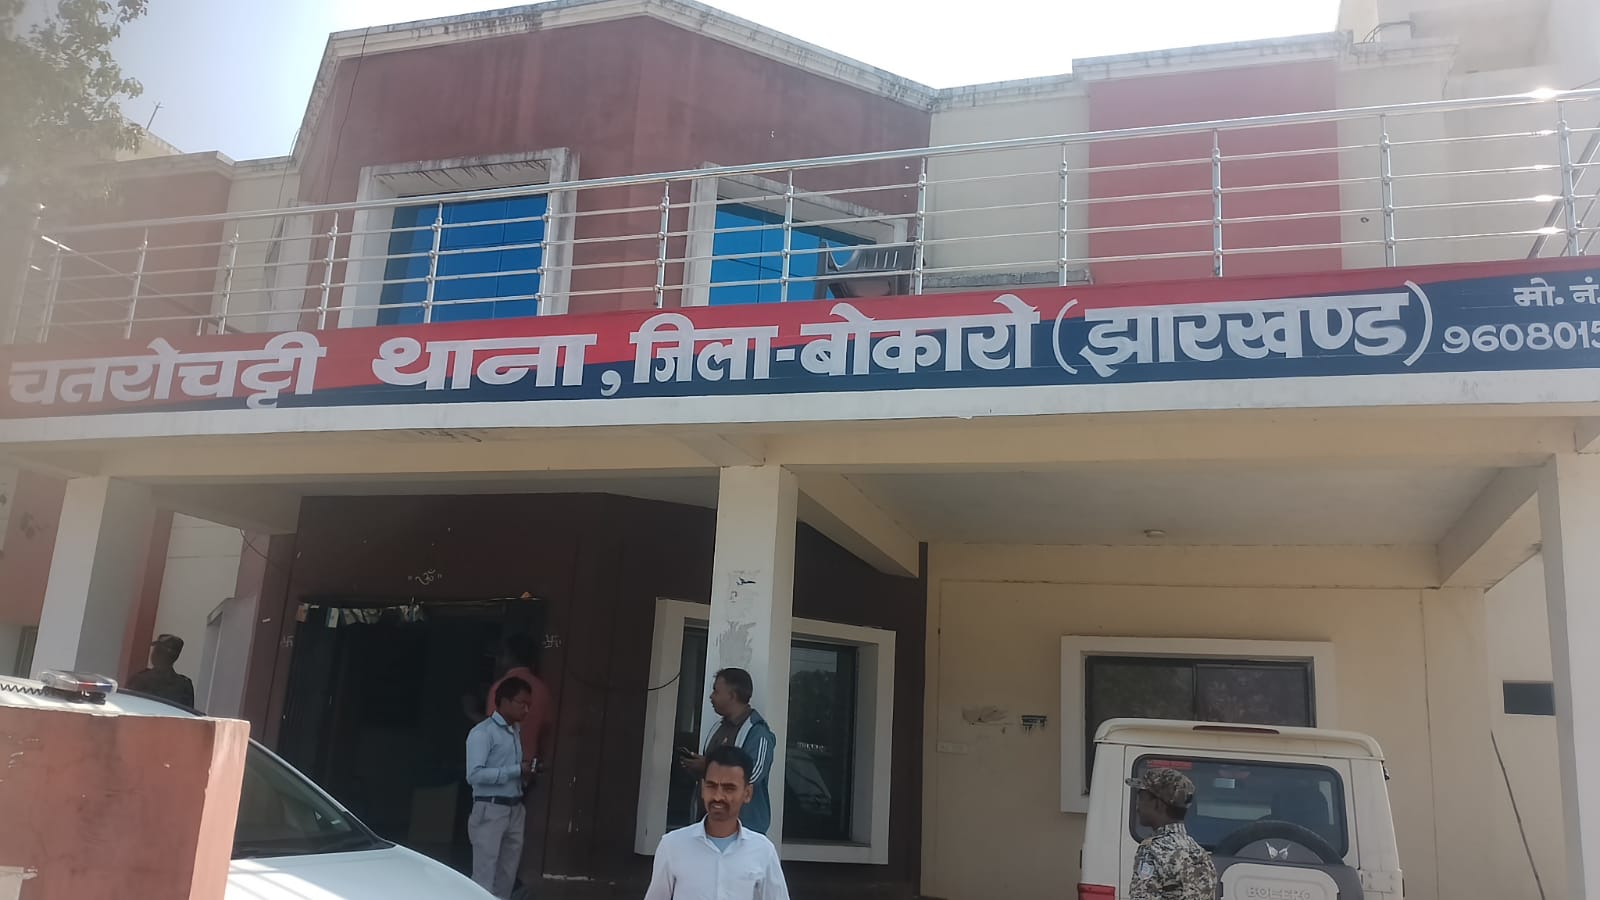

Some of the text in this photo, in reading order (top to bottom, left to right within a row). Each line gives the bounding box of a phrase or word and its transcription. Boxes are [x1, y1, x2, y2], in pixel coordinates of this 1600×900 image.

[1513, 277, 1564, 307] मो.
[9, 331, 328, 409] चतरोचट्टी
[1052, 280, 1433, 378] (झारखण्ड)
